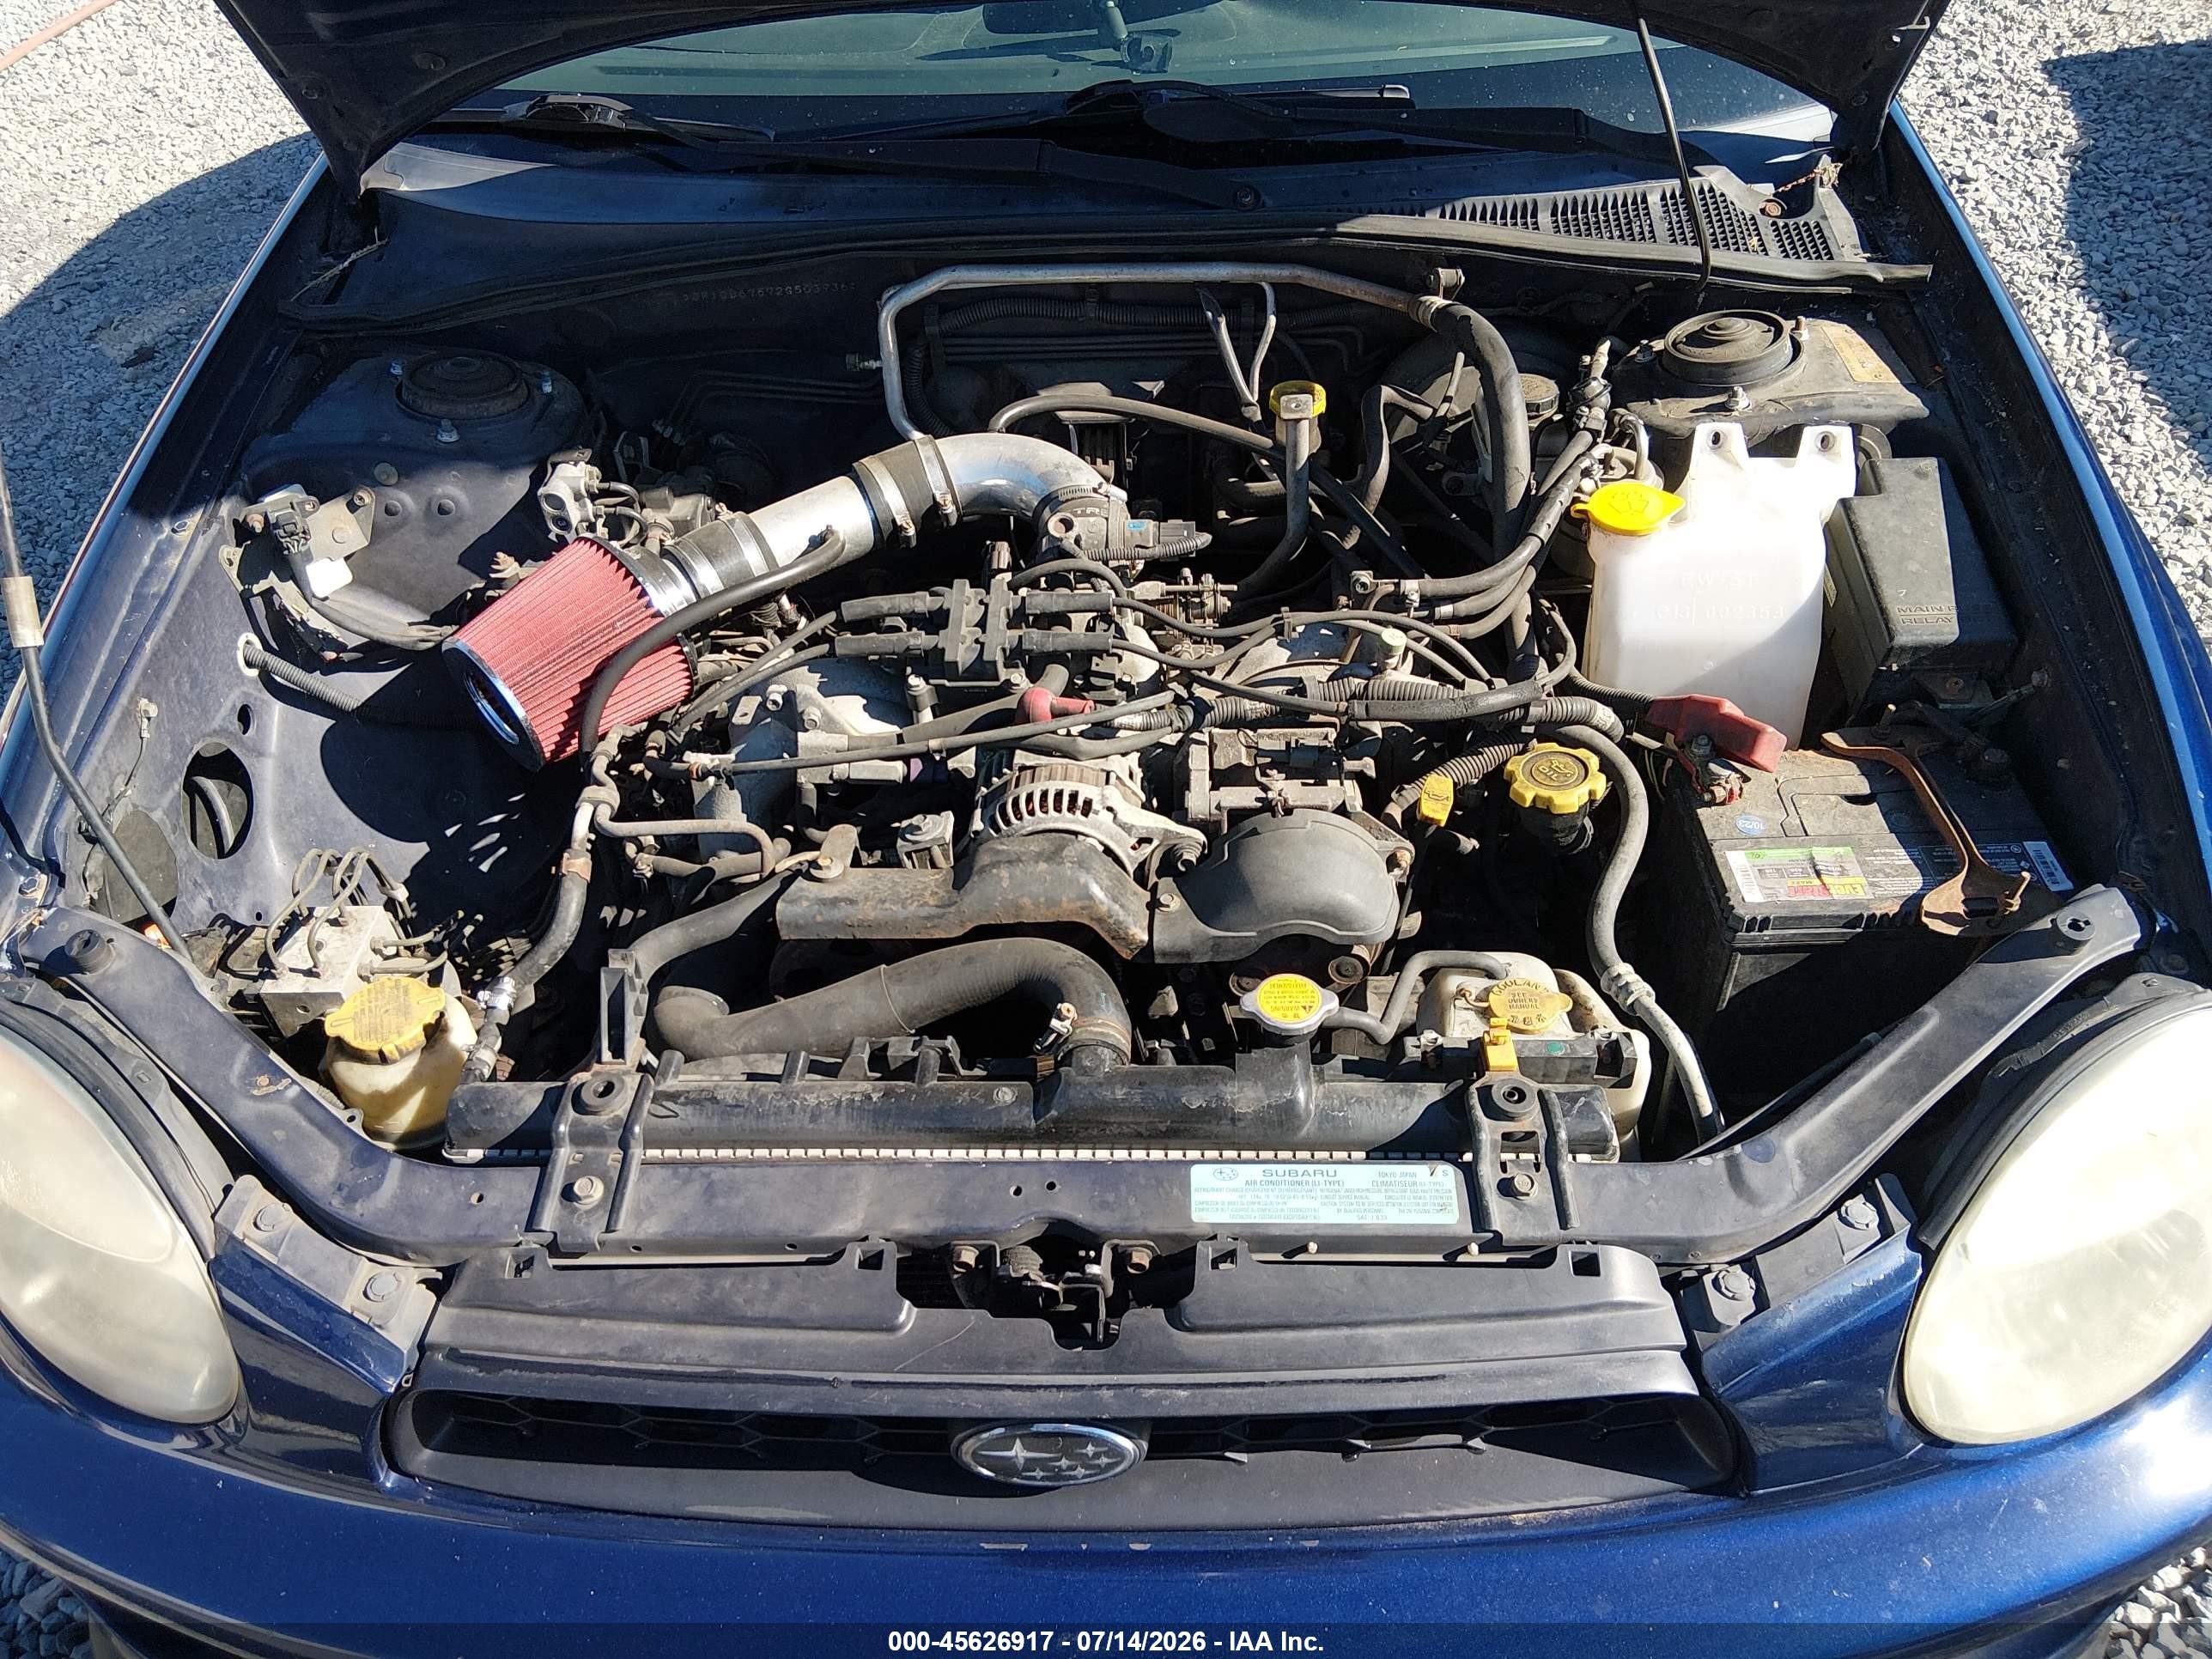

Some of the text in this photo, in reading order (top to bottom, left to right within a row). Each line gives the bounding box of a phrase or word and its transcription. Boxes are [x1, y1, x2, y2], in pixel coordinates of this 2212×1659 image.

[1896, 605, 1944, 614] MAIN
[1538, 765, 1559, 781] OIL
[1738, 818, 1765, 830] 10/23
[1262, 1169, 1337, 1177] SUBARU
